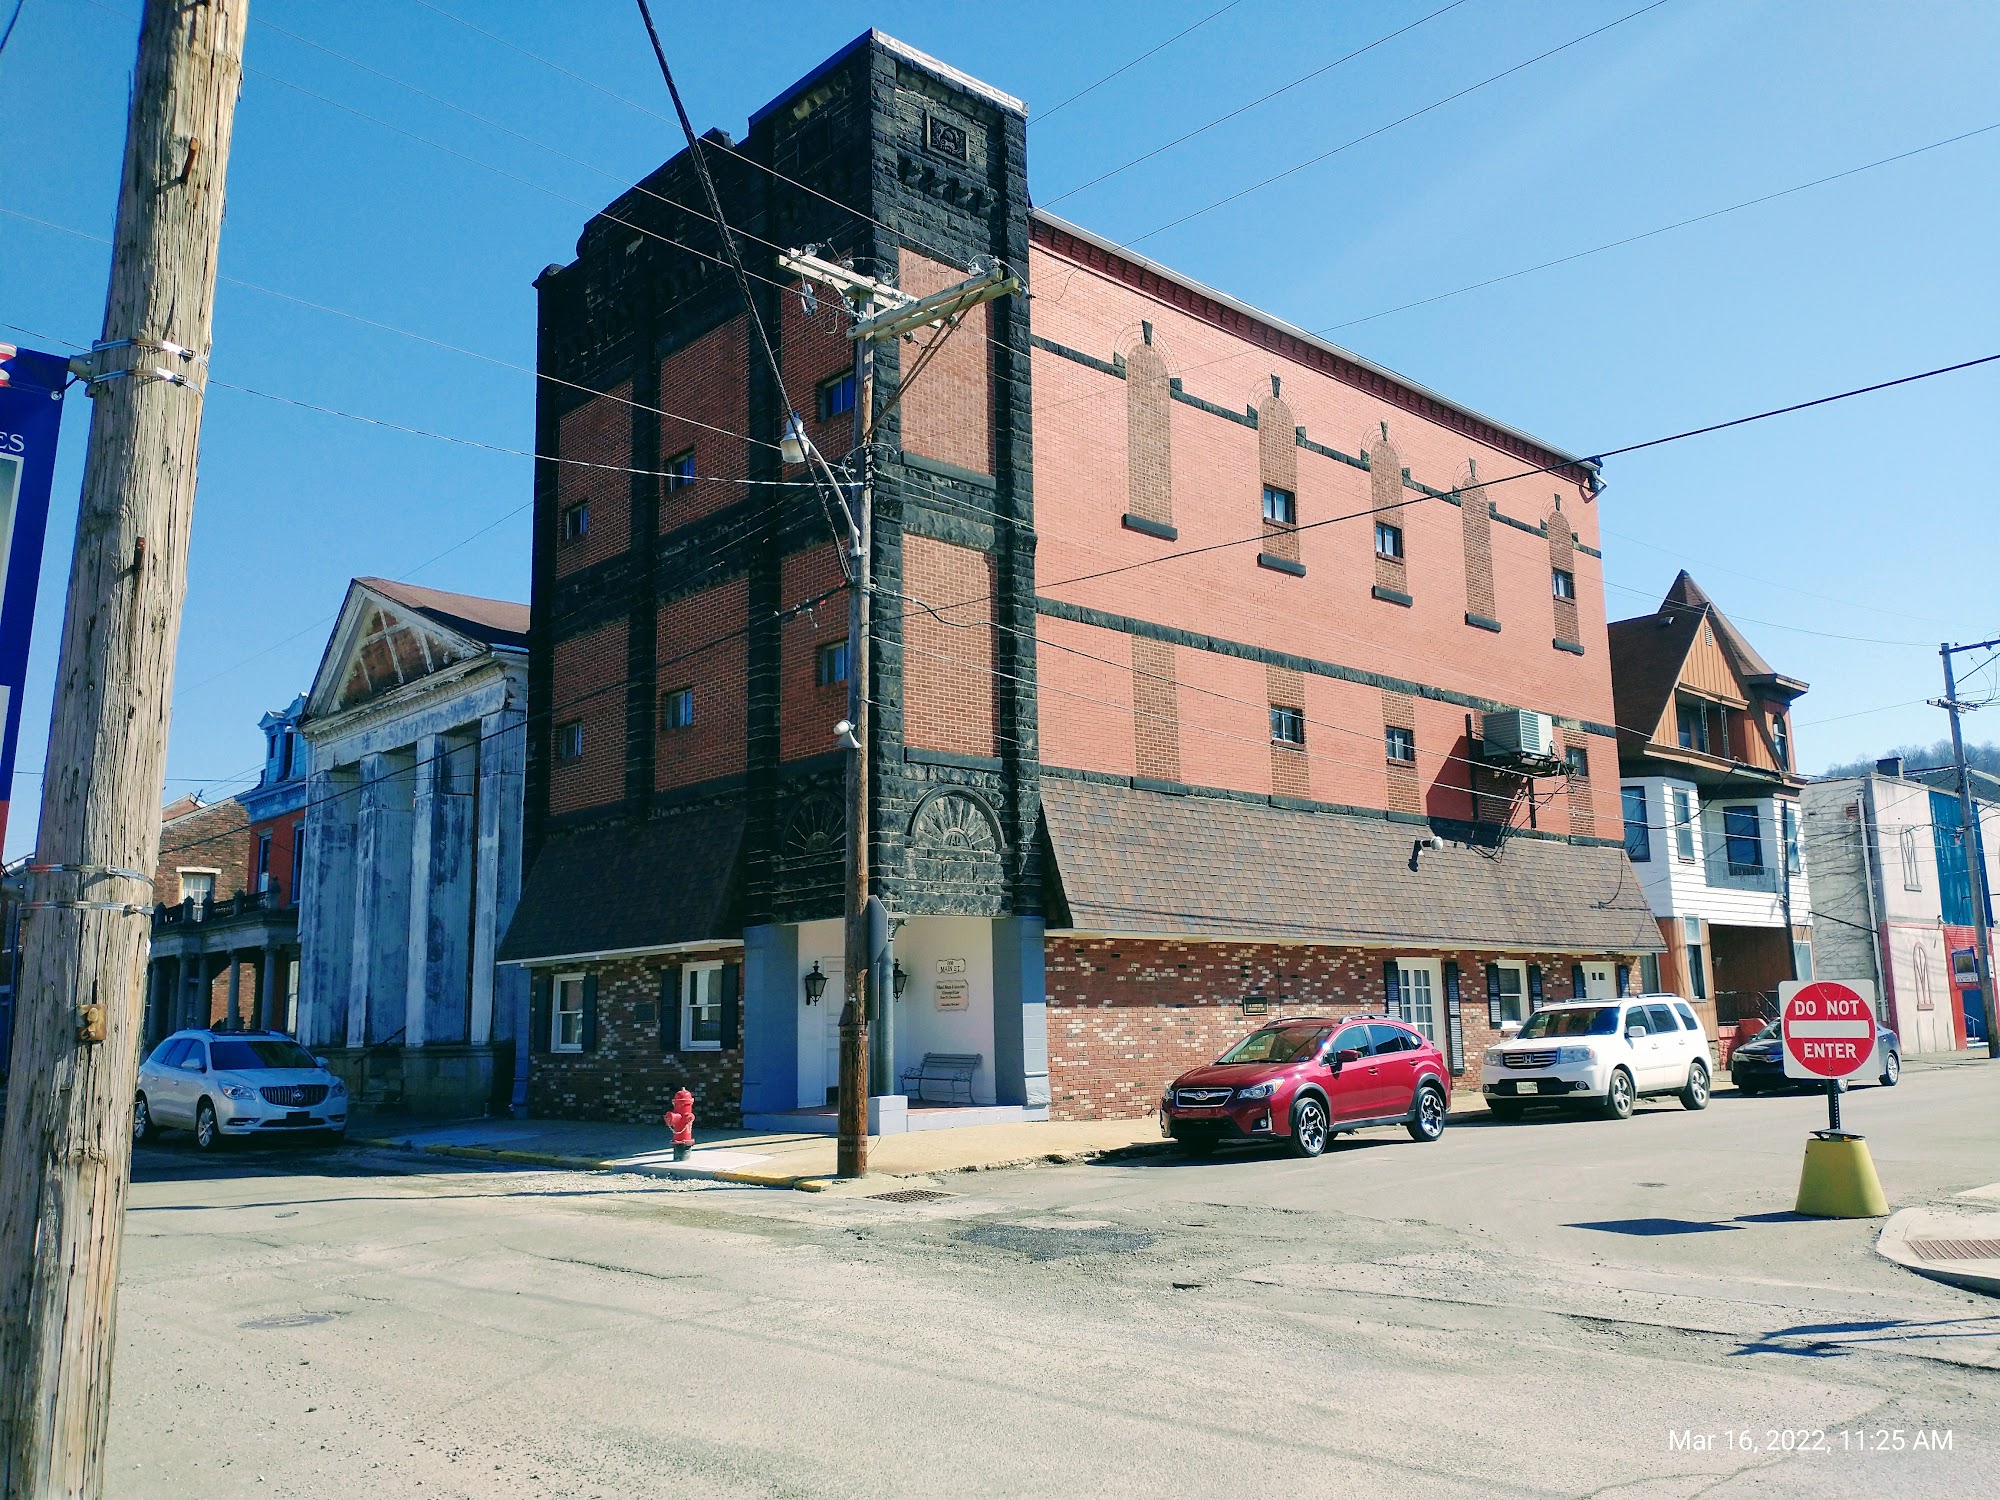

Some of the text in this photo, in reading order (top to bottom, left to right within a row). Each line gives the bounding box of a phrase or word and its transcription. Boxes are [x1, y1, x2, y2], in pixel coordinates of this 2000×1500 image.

[1795, 1000, 1859, 1016] DO NOT
[1803, 1042, 1857, 1059] ENTER
